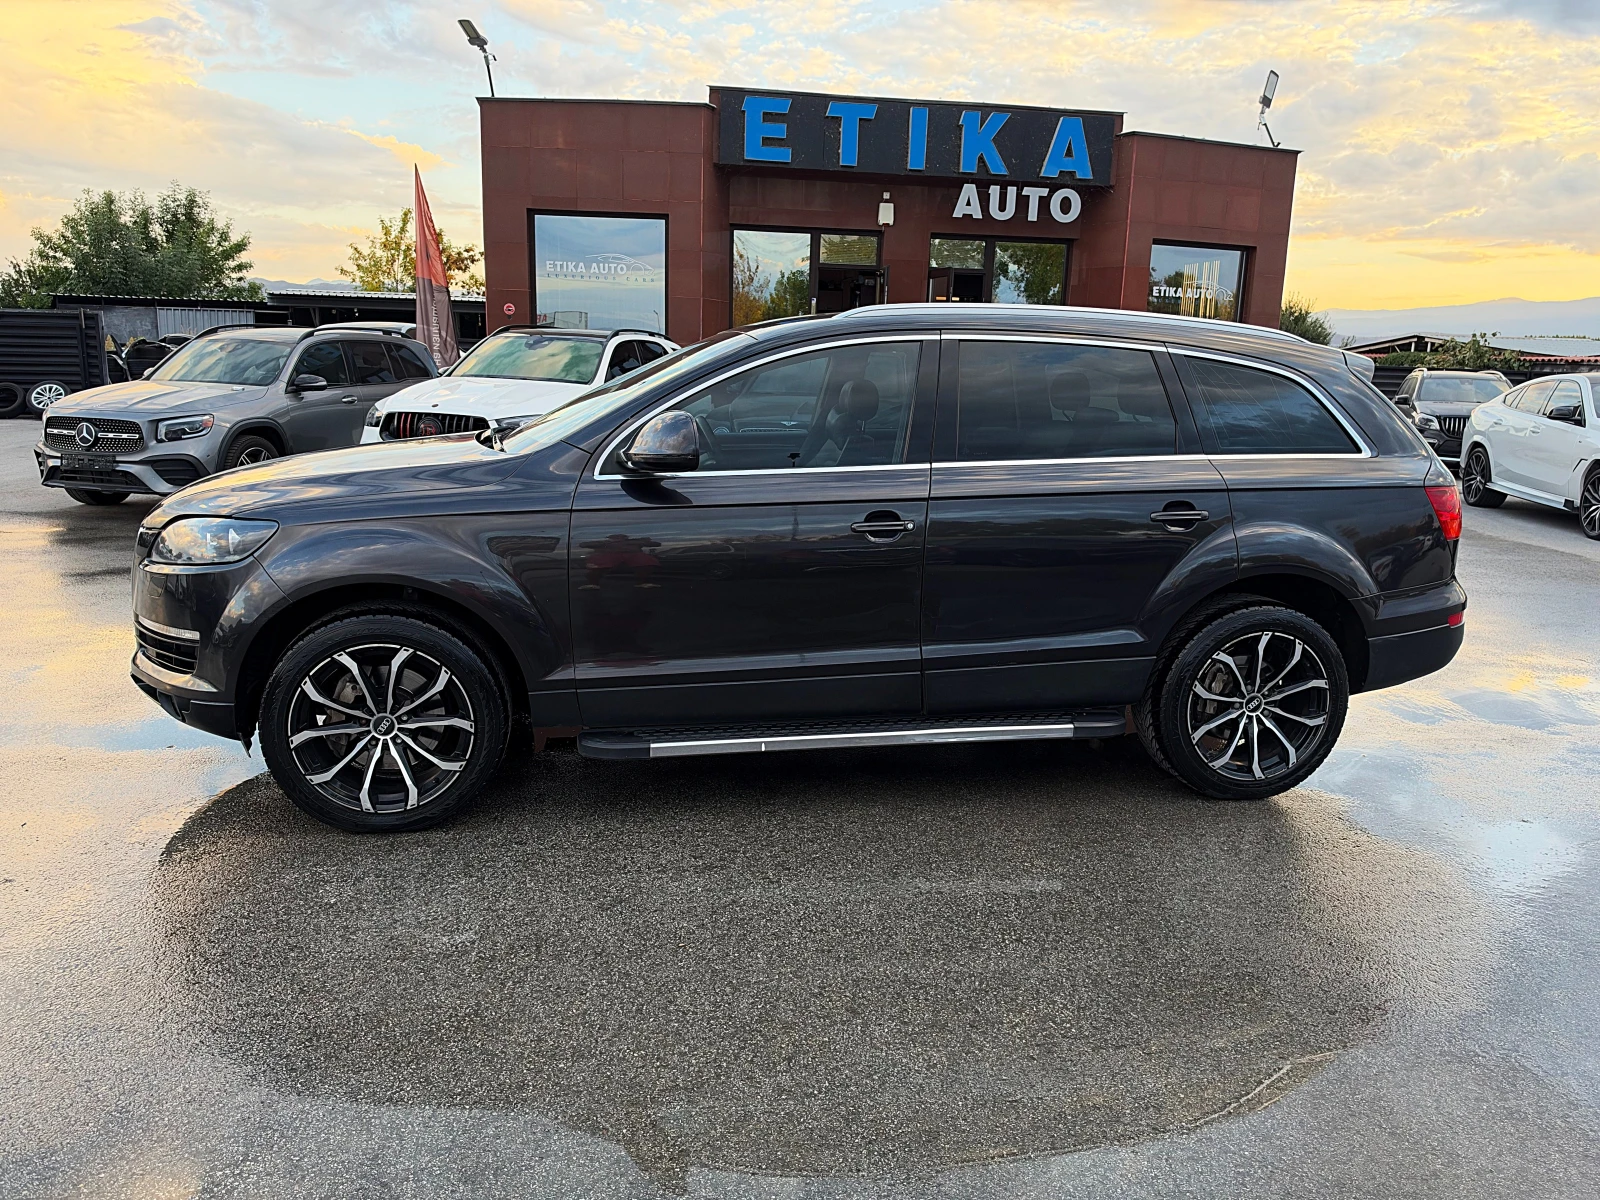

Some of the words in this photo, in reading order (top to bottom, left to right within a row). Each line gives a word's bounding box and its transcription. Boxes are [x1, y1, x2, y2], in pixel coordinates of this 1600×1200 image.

[741, 95, 1093, 179] ETIKA
[952, 184, 1081, 223] AUTO
[545, 260, 586, 273] ETIKA
[590, 263, 627, 275] AUTO
[547, 273, 617, 281] LUXURIOUS
[1152, 286, 1183, 298] ETIKA
[1185, 288, 1214, 299] AUTO
